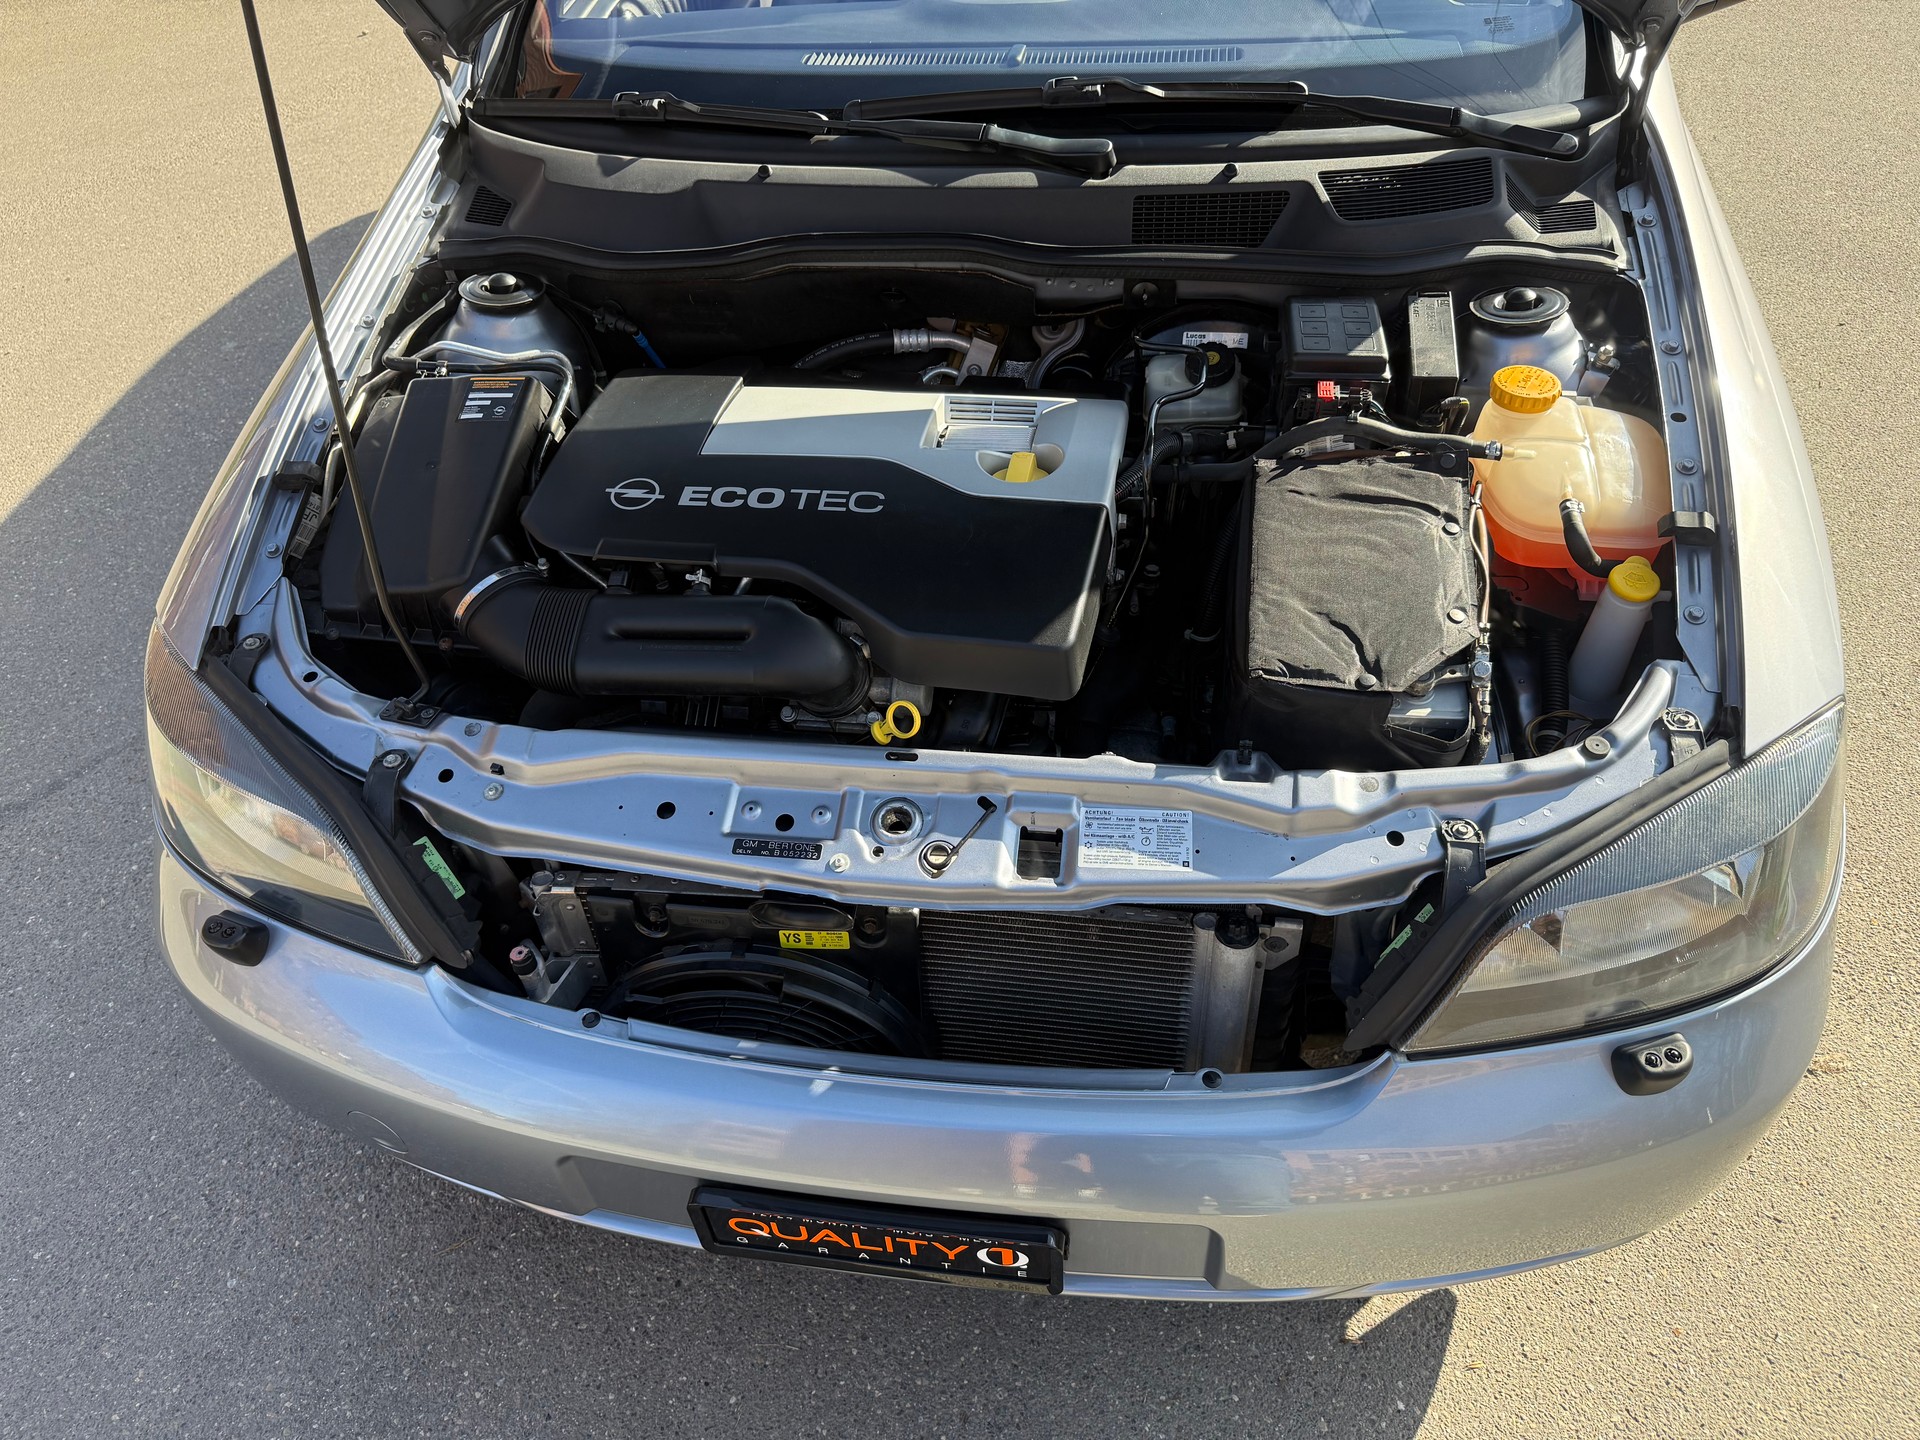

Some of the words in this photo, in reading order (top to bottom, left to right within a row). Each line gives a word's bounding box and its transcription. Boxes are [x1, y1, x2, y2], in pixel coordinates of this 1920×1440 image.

[678, 486, 885, 513] ECOTEC
[742, 840, 759, 848] GM
[768, 842, 816, 852] BERTONE
[783, 850, 818, 859] 052232
[782, 933, 802, 944] YS
[728, 1217, 970, 1261] QUALITY
